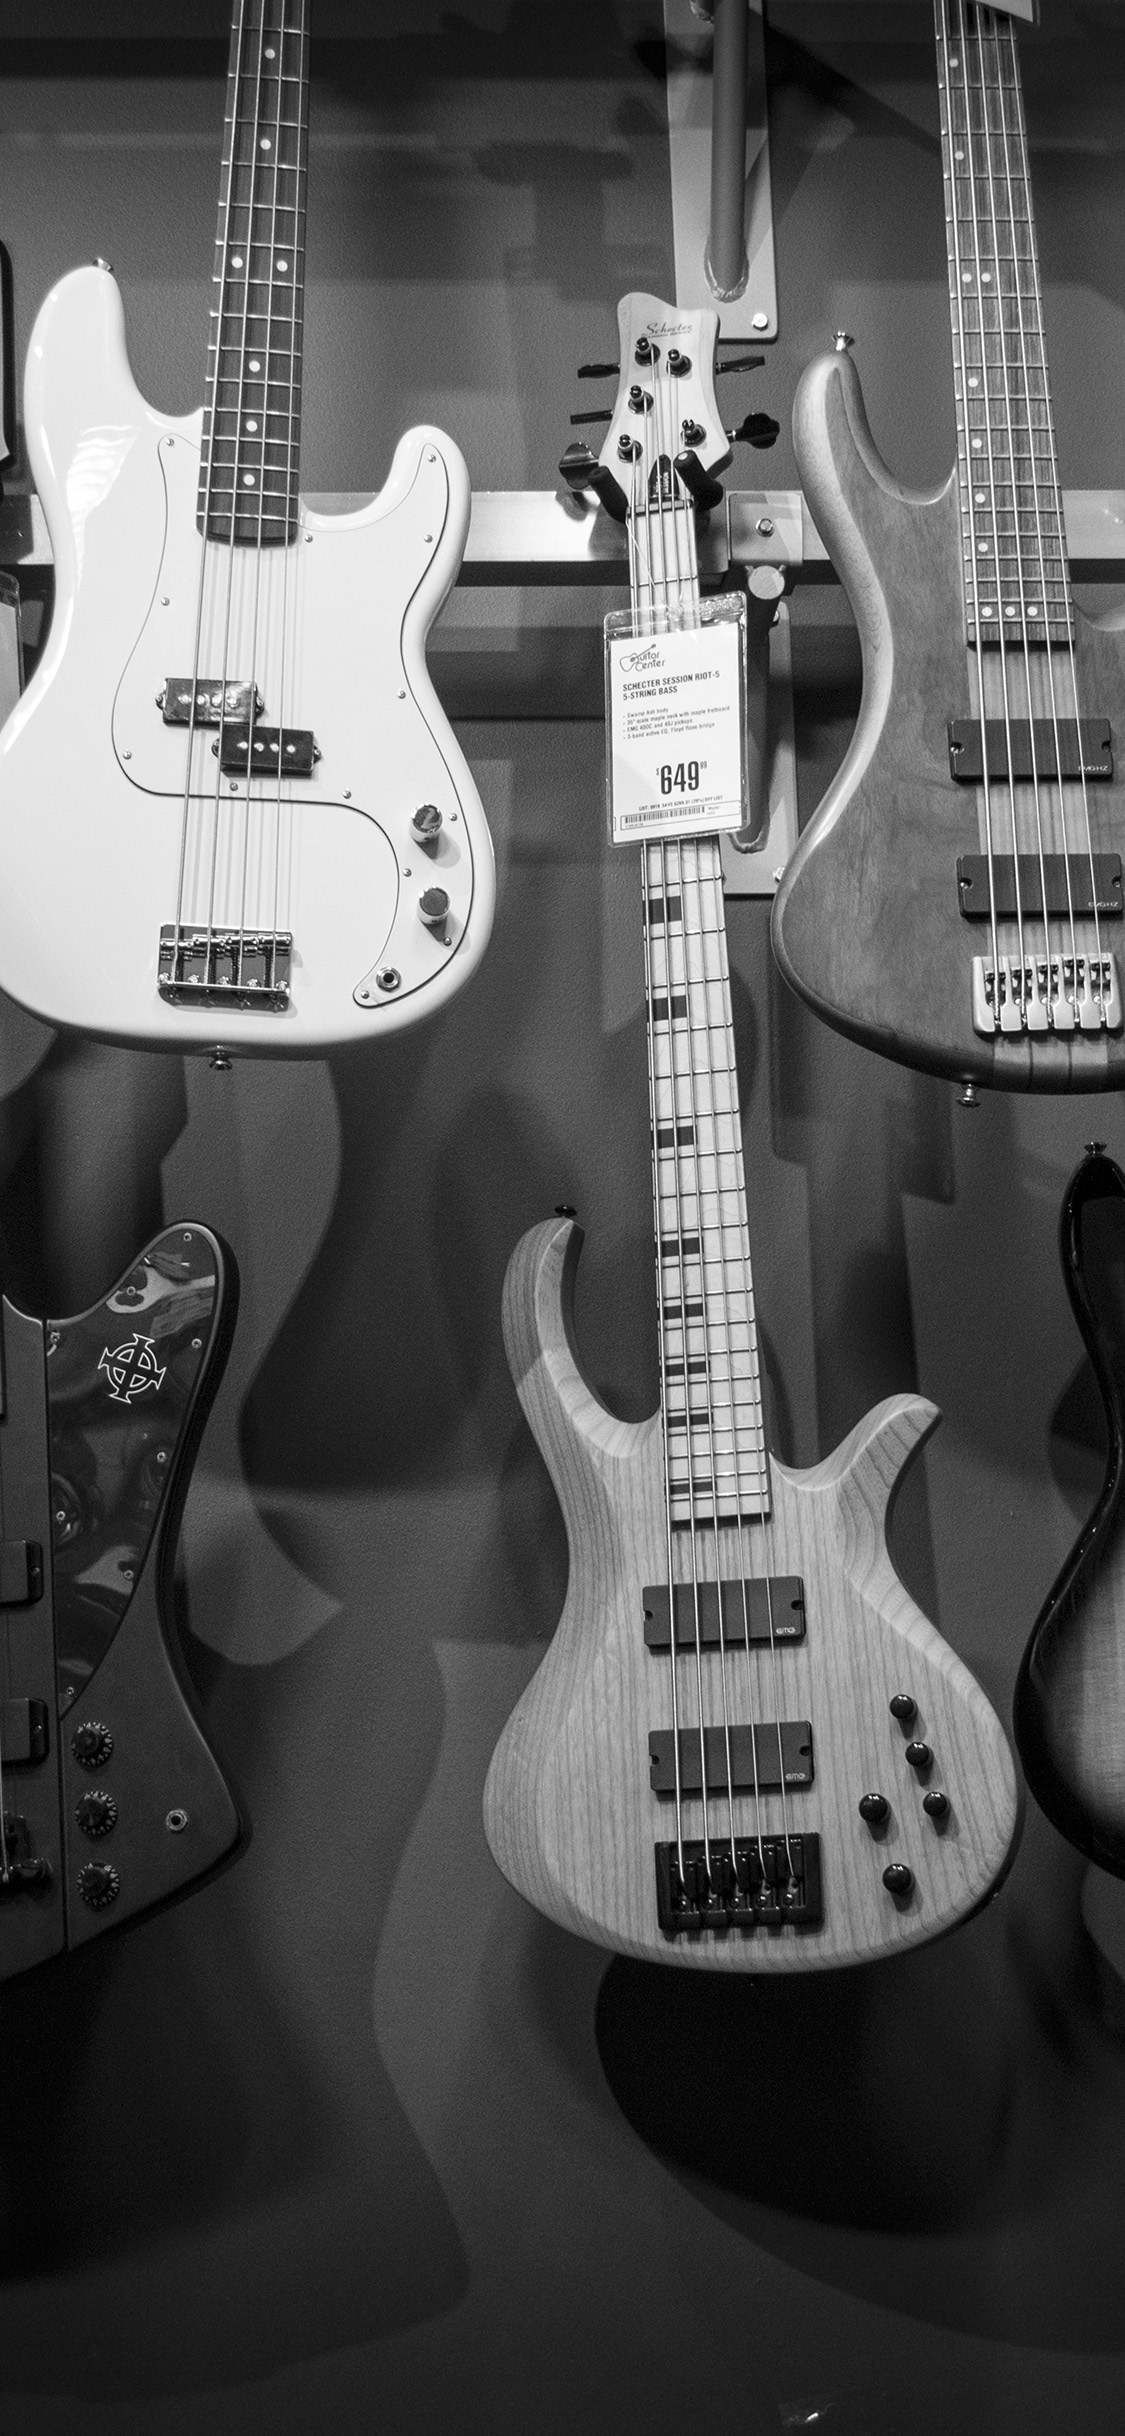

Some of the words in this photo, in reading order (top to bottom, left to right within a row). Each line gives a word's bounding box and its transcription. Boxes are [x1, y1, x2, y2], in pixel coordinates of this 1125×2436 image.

[635, 659, 666, 672] Center
[623, 678, 661, 692] SCHECTER
[662, 674, 693, 686] SESSION
[695, 670, 720, 681] RIOT-5
[623, 688, 657, 701] 5-STRING
[658, 685, 678, 695] BASS
[707, 705, 730, 714] fretboard
[674, 718, 693, 727] pickups
[670, 726, 684, 734] Floyd
